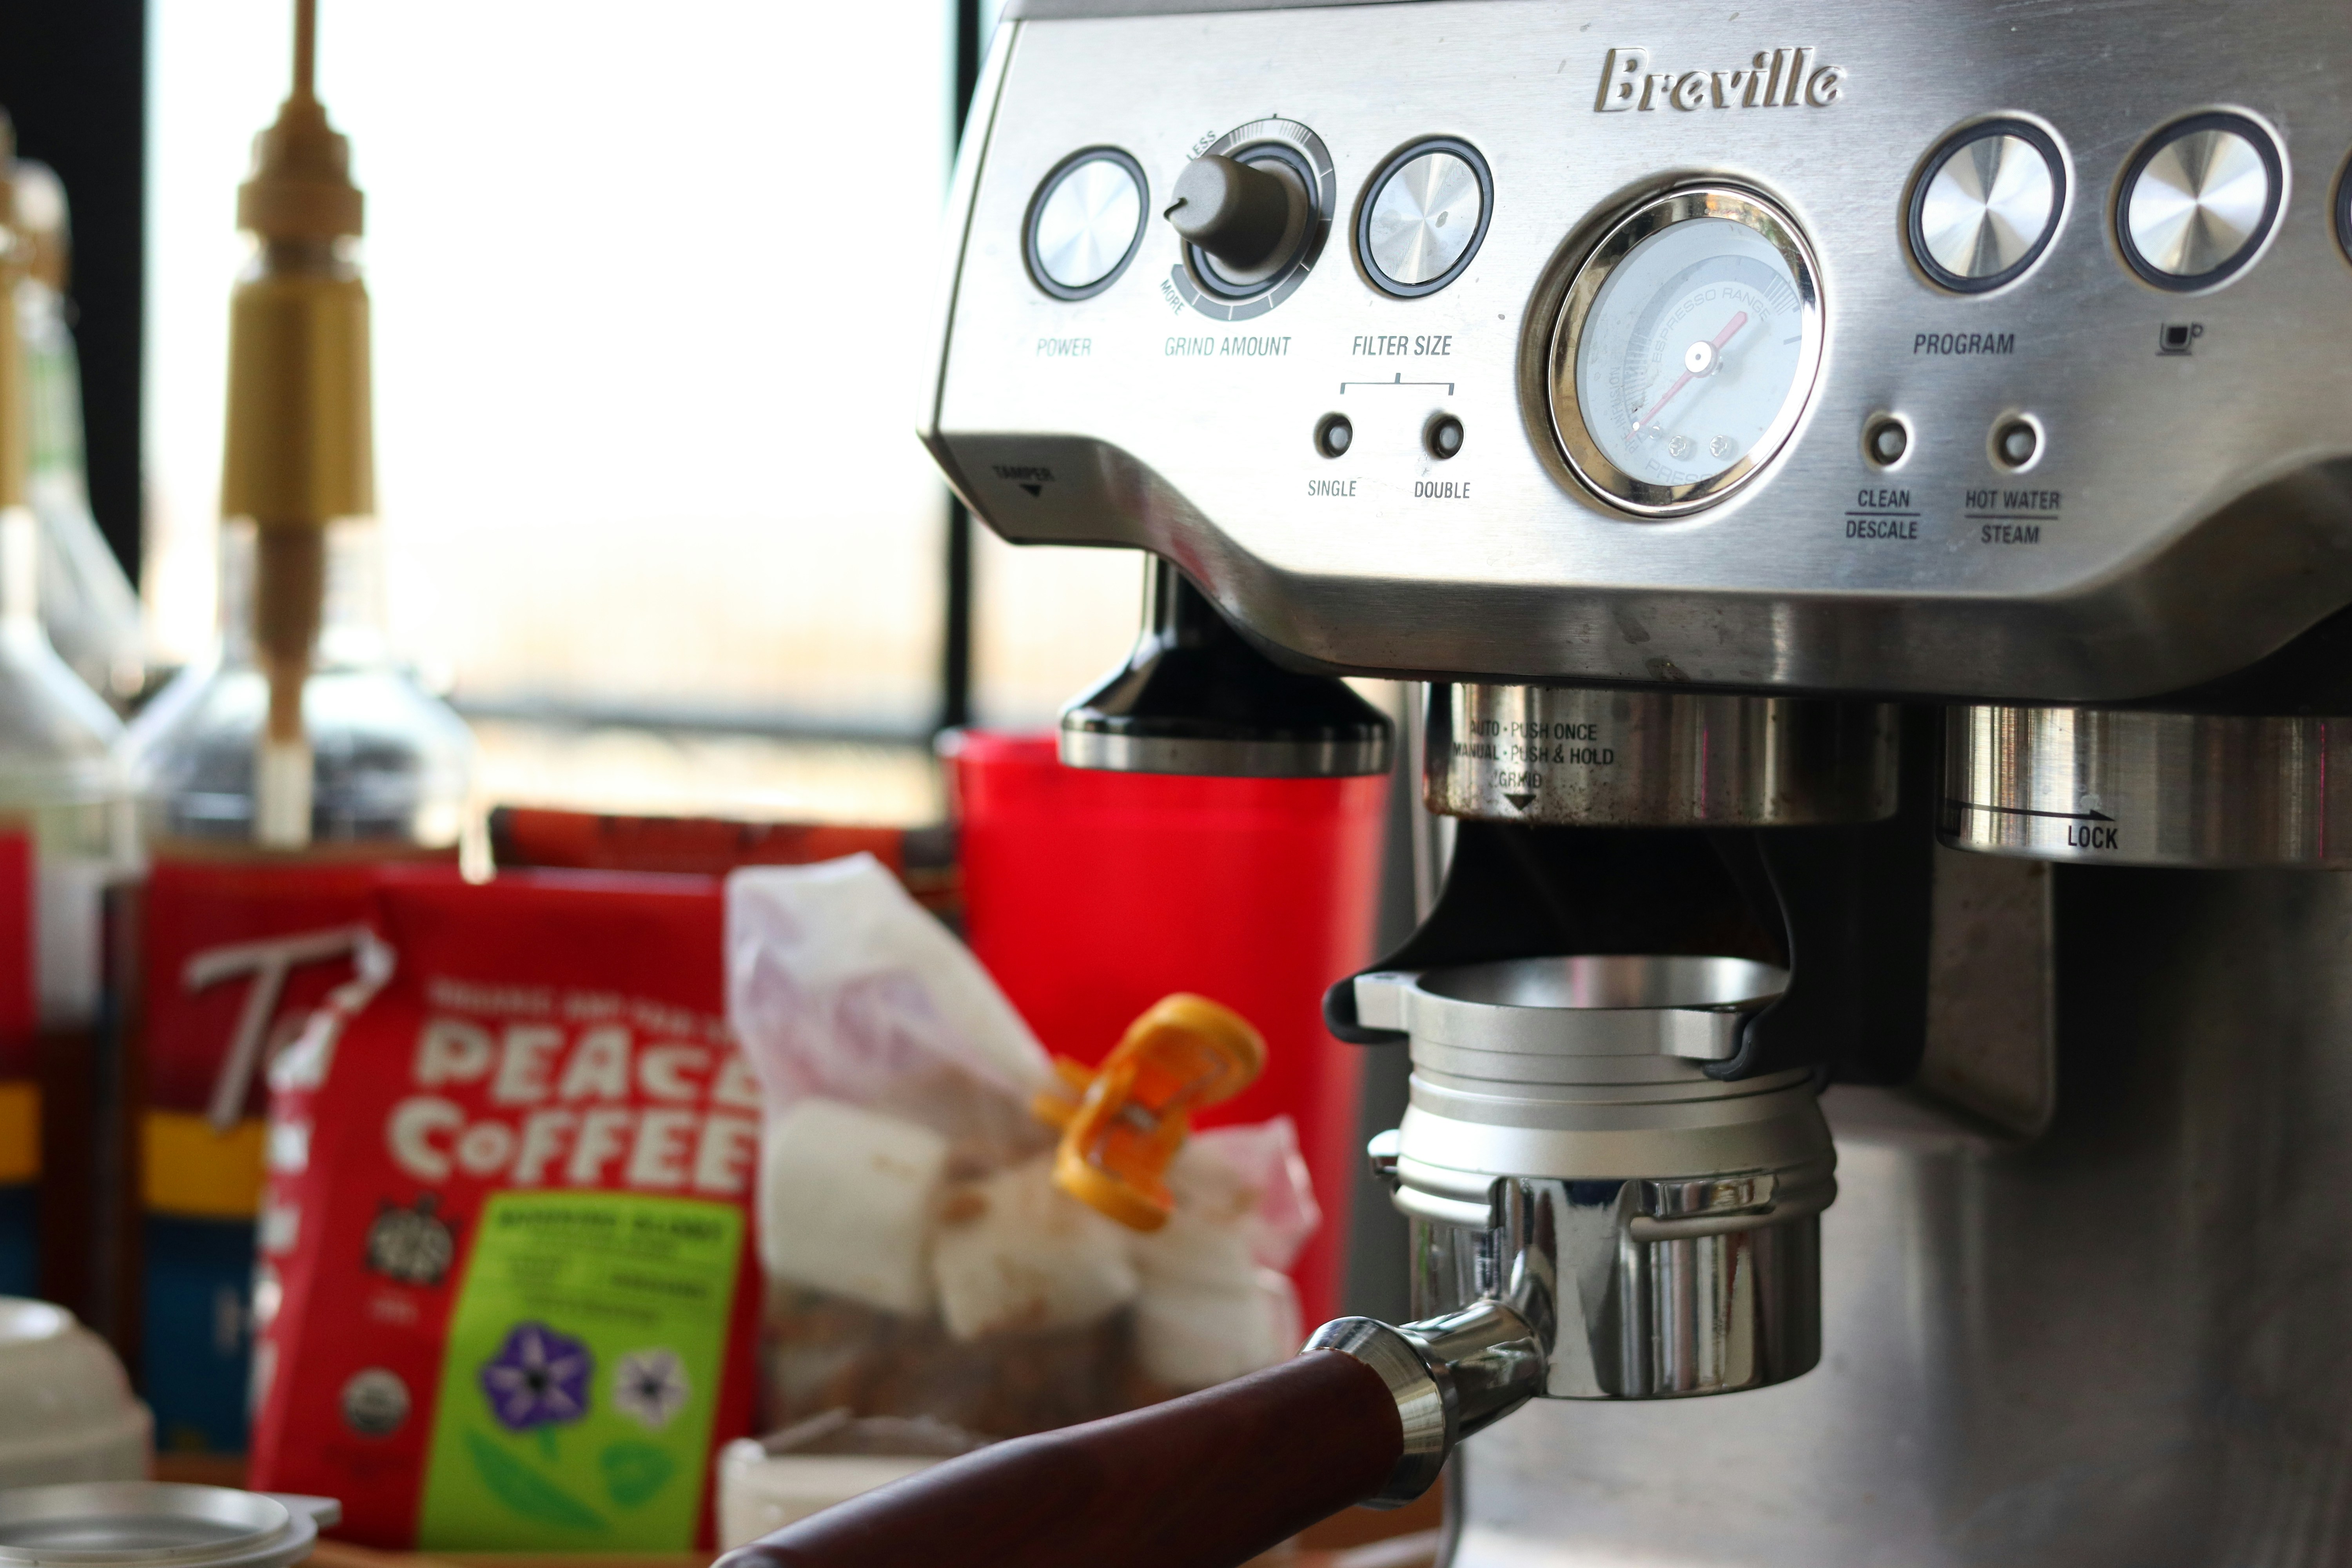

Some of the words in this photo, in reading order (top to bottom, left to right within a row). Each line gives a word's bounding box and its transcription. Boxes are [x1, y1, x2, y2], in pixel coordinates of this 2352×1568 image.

[1594, 46, 1847, 112] Breville
[1186, 130, 1216, 161] LESS
[1160, 279, 1185, 315] MORE
[1652, 289, 1717, 363] ESPRESSO
[1722, 287, 1769, 320] RANGE
[1036, 338, 1092, 357] POWER
[1164, 337, 1214, 356] GRIND
[1220, 336, 1291, 356] AMOUNT
[1352, 336, 1408, 356] FILTER
[1414, 336, 1452, 356] SIZE
[1913, 333, 2015, 355] PROGRAM
[1308, 480, 1356, 497] SINGLE
[1414, 481, 1470, 499] DOUBLE
[1857, 489, 1910, 508] CLEAN
[1965, 490, 1997, 508] HOT
[2003, 490, 2060, 510] WATER
[1846, 520, 1918, 539] DESCALE
[1981, 525, 2039, 544] STEAM
[1470, 720, 1499, 737] AUTO
[1512, 722, 1548, 739] PUSH
[1554, 723, 1597, 741] ONCE
[1453, 742, 1499, 760] MANUAL
[1512, 745, 1548, 763] PUSH
[1553, 745, 1564, 763] &
[1570, 748, 1614, 765] HOLD
[2068, 825, 2118, 849] LOCK
